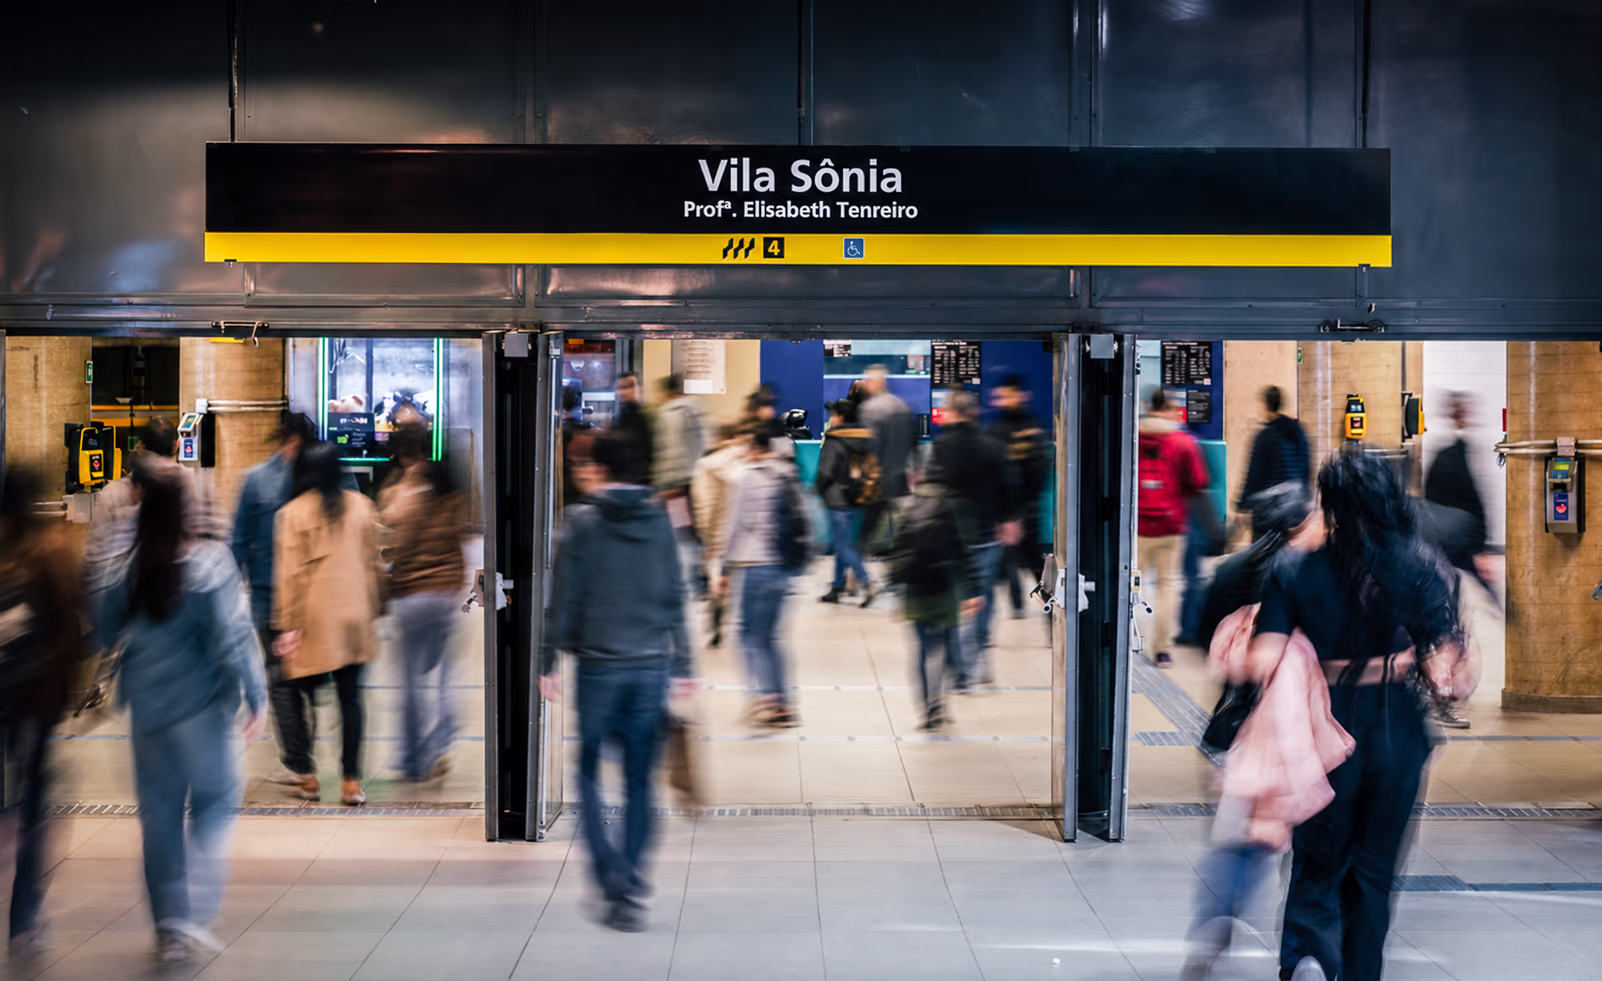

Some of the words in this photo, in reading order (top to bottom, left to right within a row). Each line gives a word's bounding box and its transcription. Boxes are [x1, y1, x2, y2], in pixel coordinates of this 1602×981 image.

[698, 157, 775, 192] Vila
[790, 158, 902, 193] Sônia
[743, 200, 831, 218] Elisabeth
[836, 201, 918, 219] Tenreiro
[767, 240, 781, 256] 4
